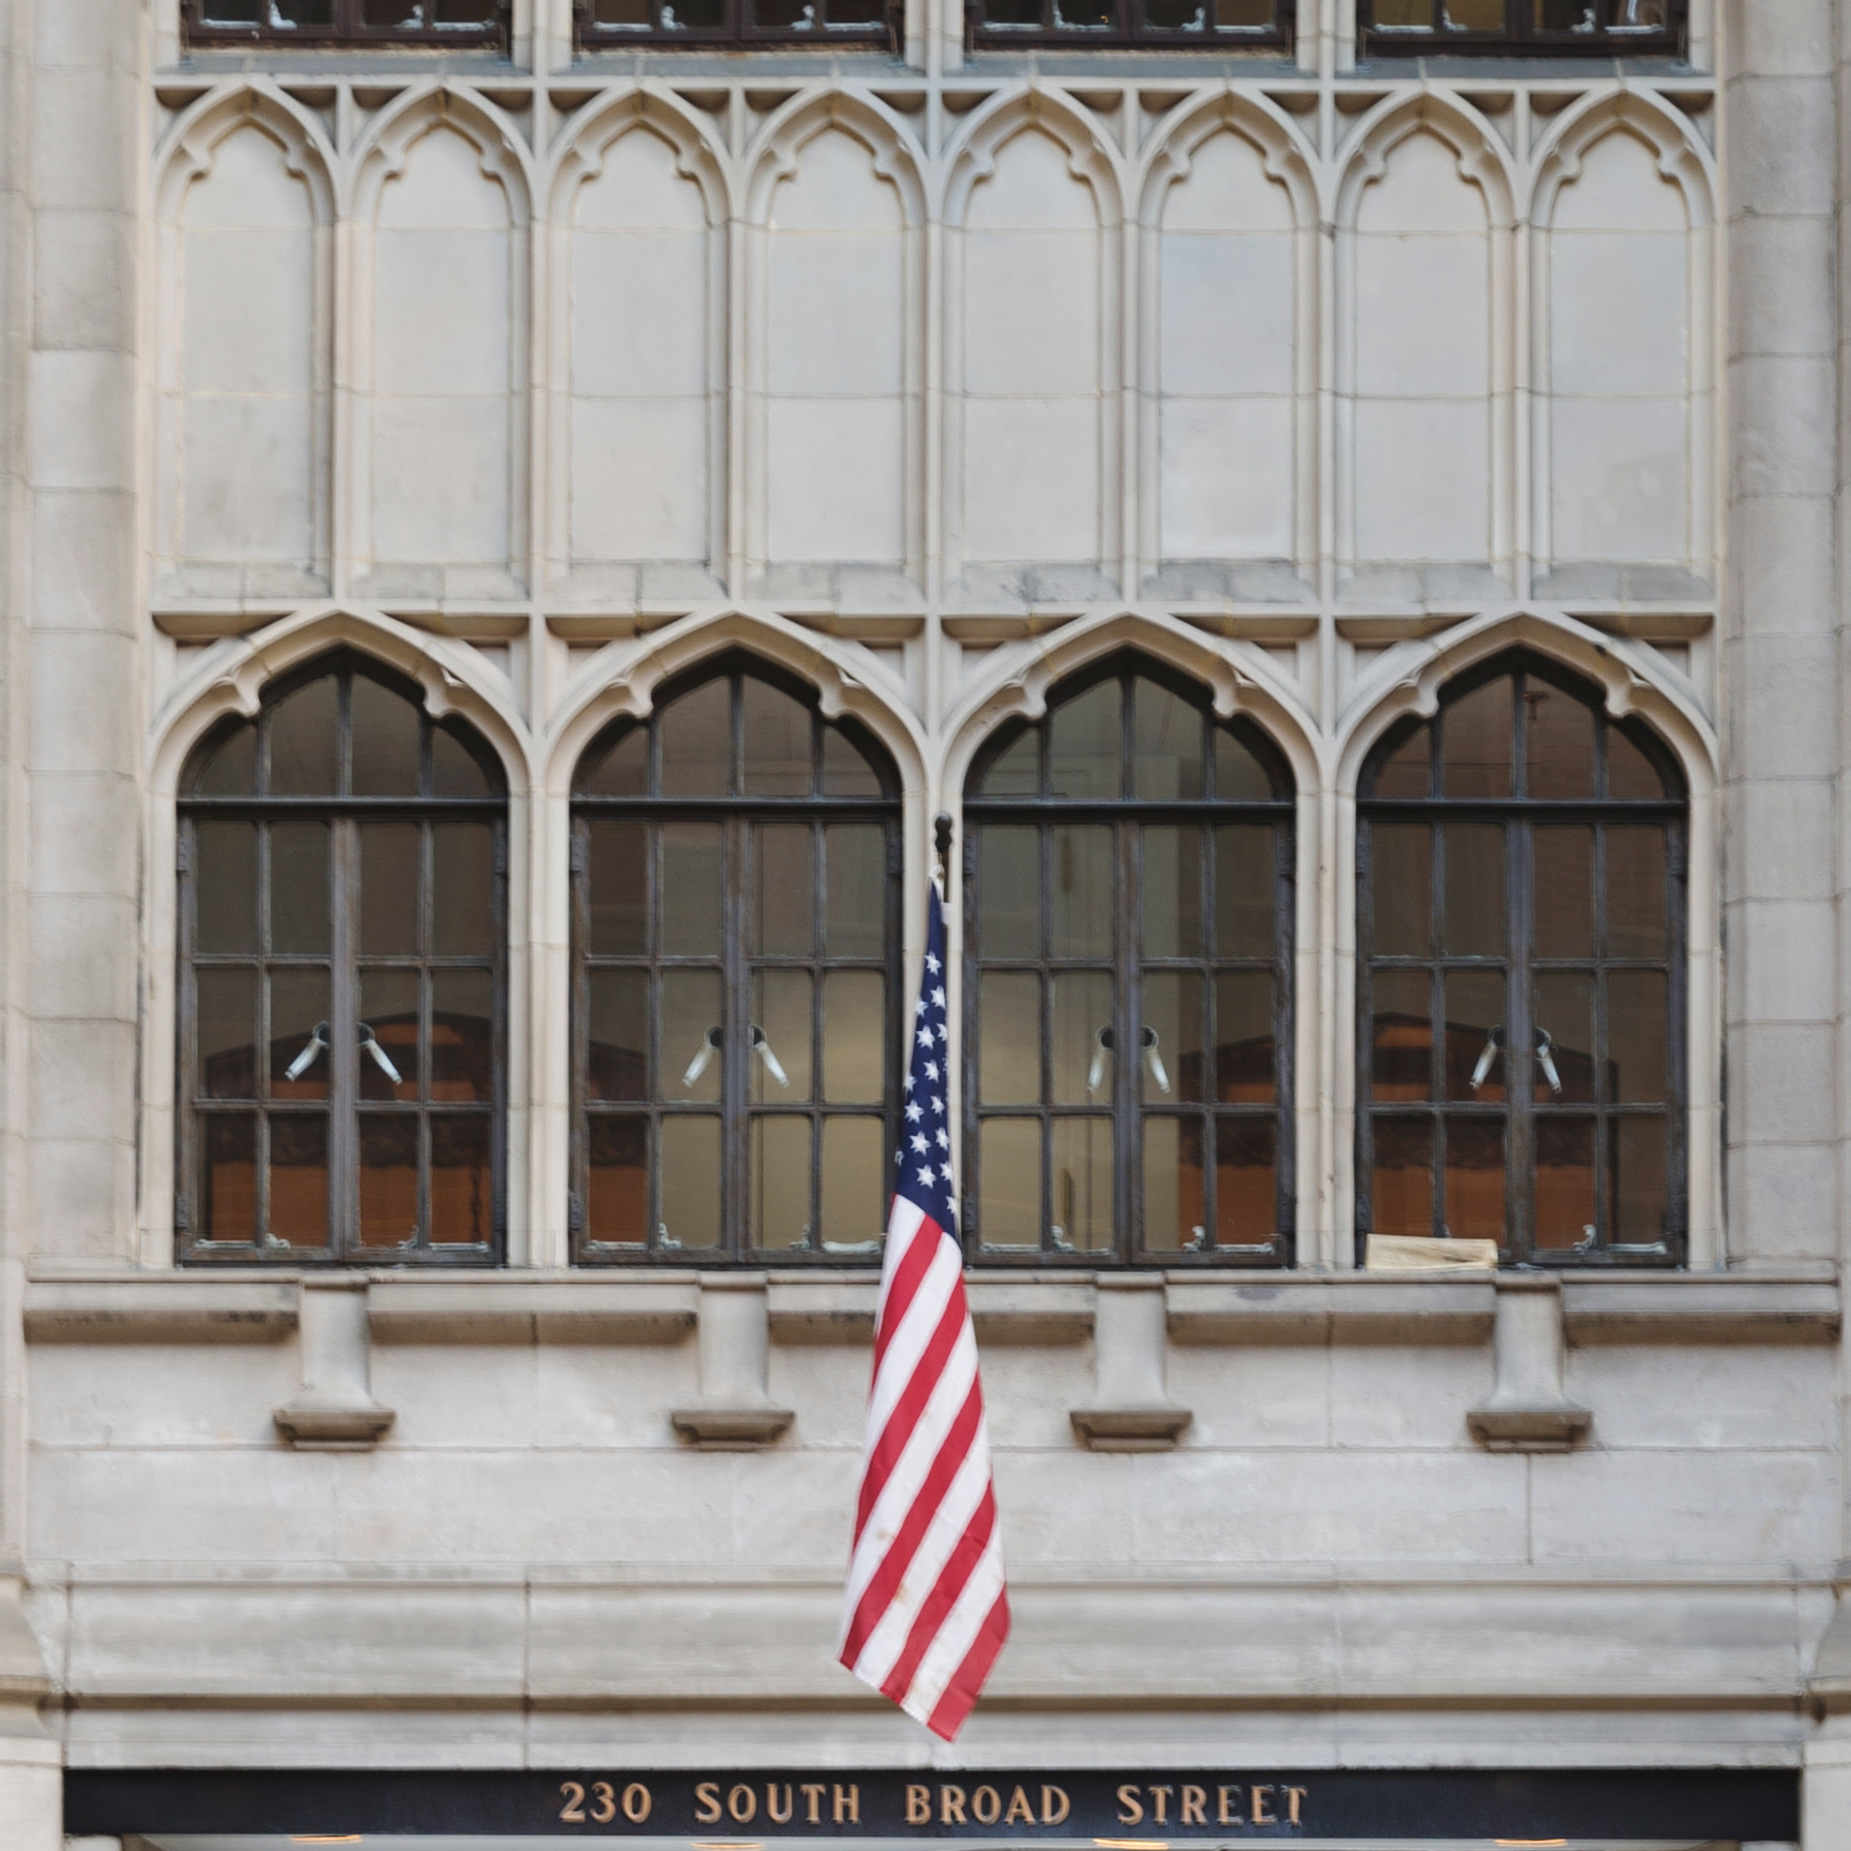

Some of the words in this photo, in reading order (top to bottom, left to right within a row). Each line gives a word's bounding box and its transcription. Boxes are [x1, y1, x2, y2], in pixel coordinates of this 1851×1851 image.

[559, 1781, 652, 1824] 230
[695, 1782, 860, 1824] SOUTH
[905, 1784, 1071, 1825] BROAD
[1117, 1784, 1308, 1826] STREET
